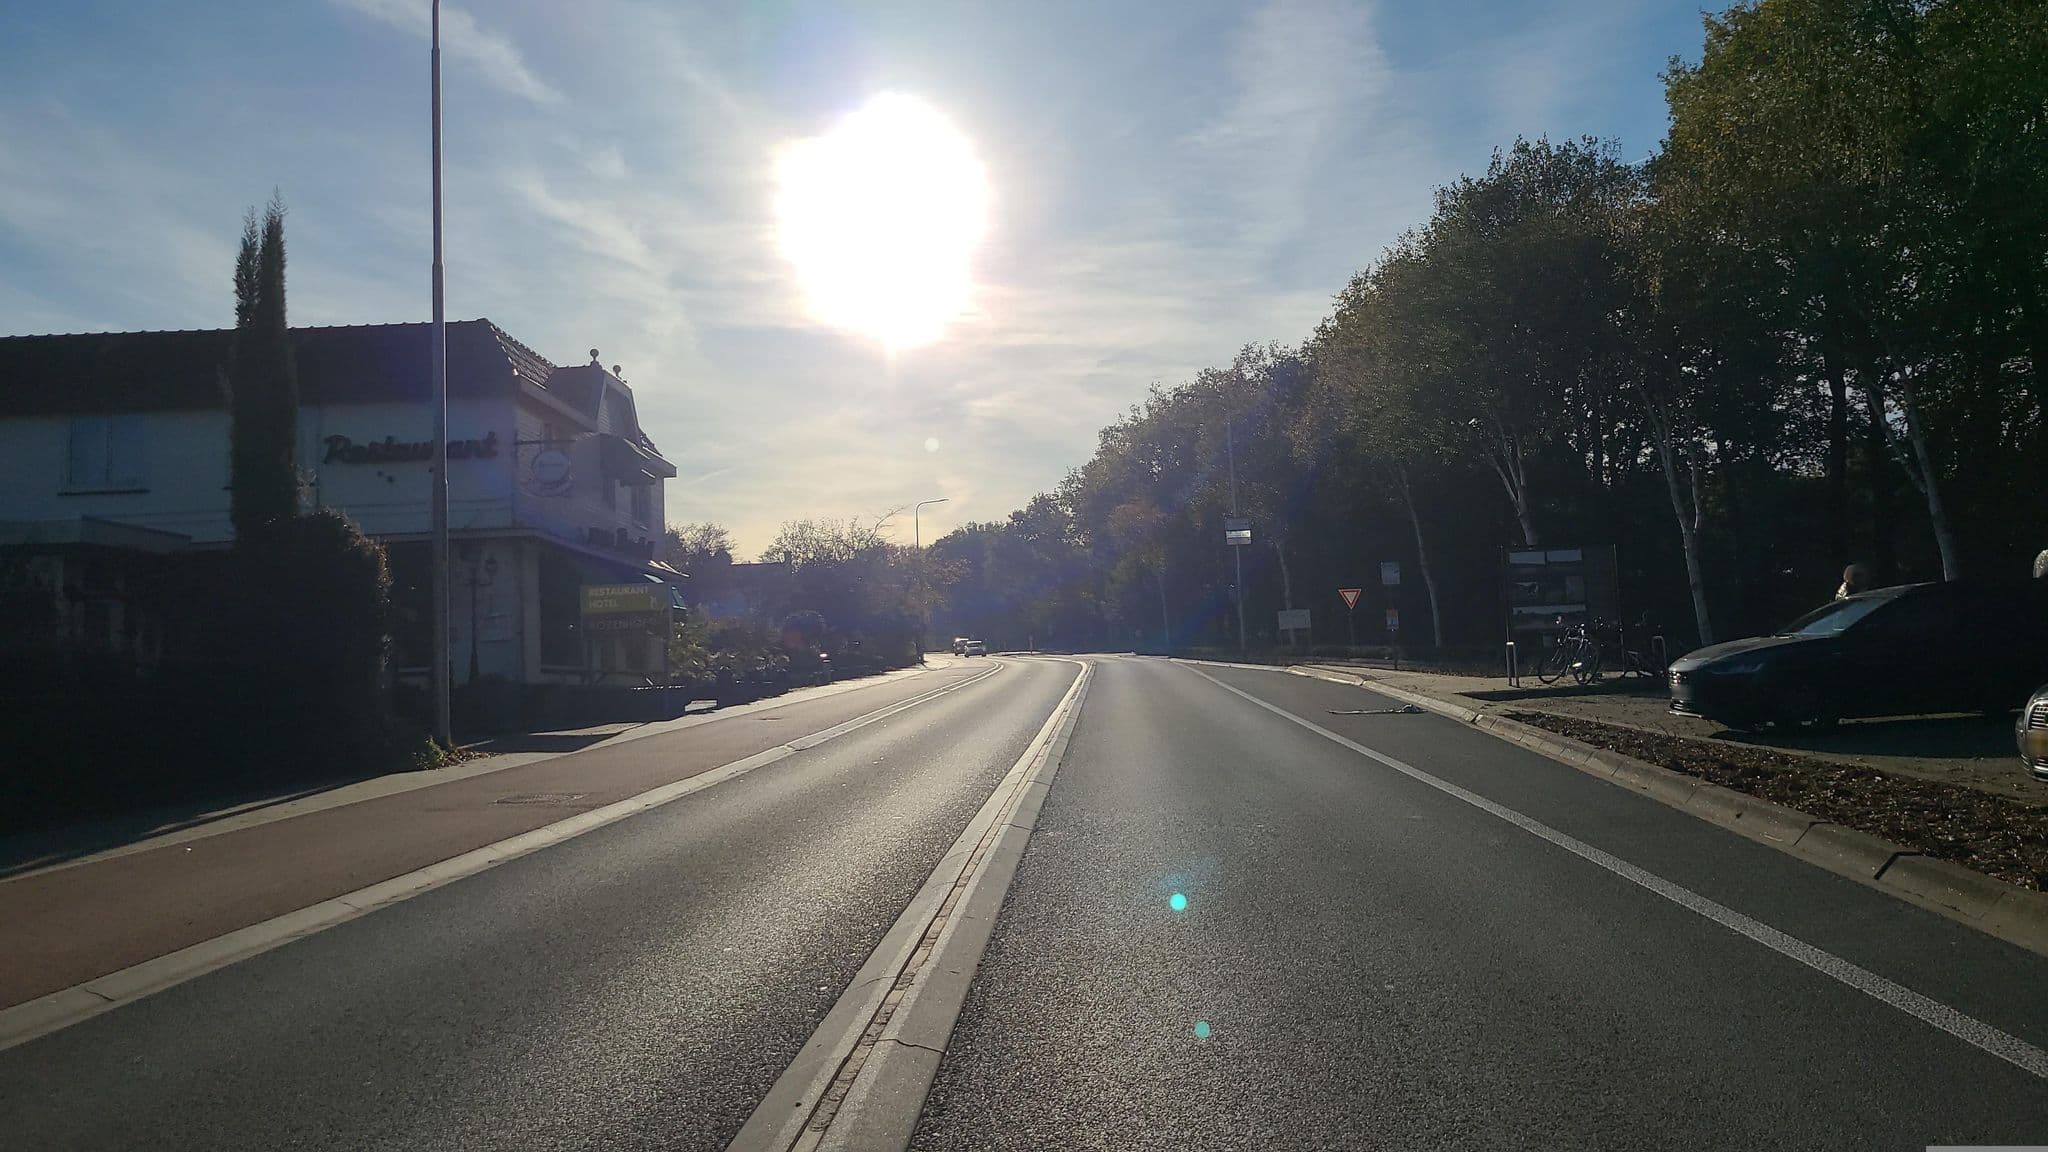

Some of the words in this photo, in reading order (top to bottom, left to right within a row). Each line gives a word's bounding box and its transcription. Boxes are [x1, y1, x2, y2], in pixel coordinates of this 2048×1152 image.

[323, 431, 498, 465] Restauant
[588, 586, 649, 597] RESTAURANT
[588, 599, 619, 609] HOTEL
